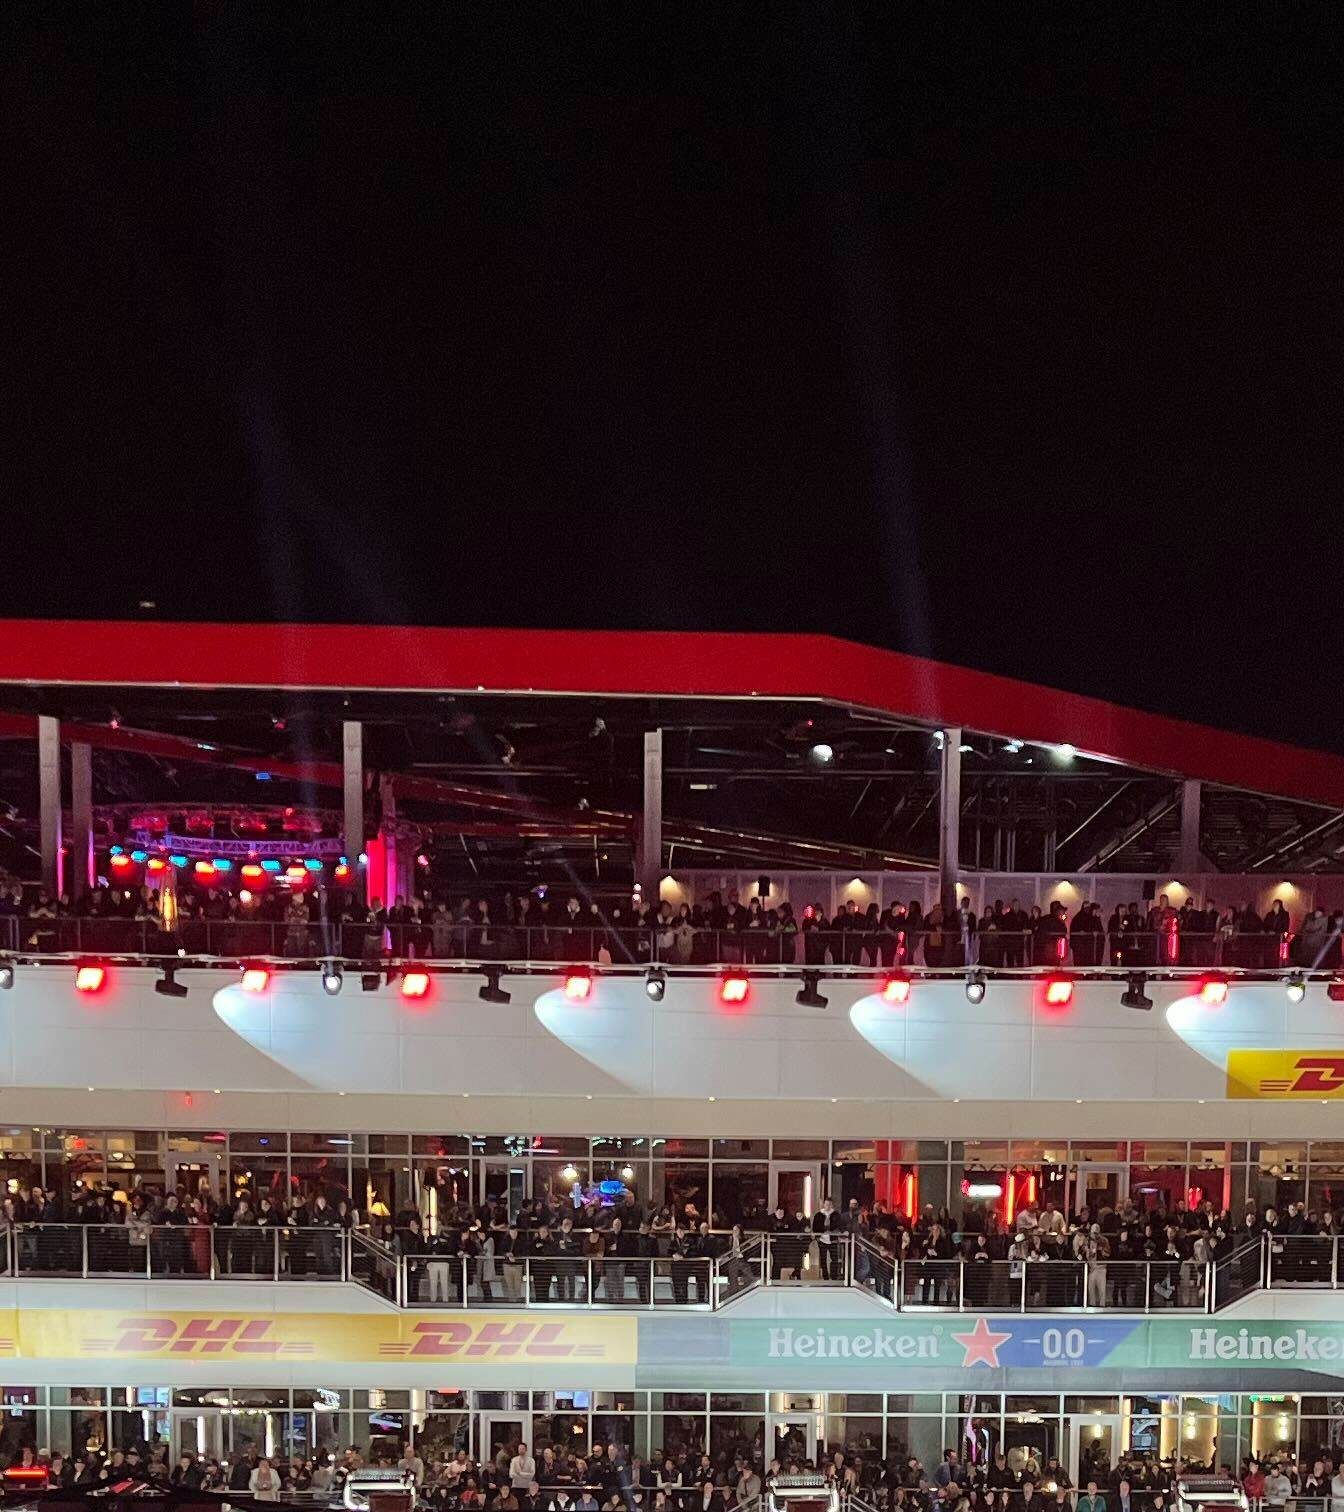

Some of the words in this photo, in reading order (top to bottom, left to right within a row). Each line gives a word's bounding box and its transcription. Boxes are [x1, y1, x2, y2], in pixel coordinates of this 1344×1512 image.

[114, 1319, 282, 1353] DHL
[409, 1322, 575, 1356] DHL
[1043, 1329, 1085, 1359] 0.0
